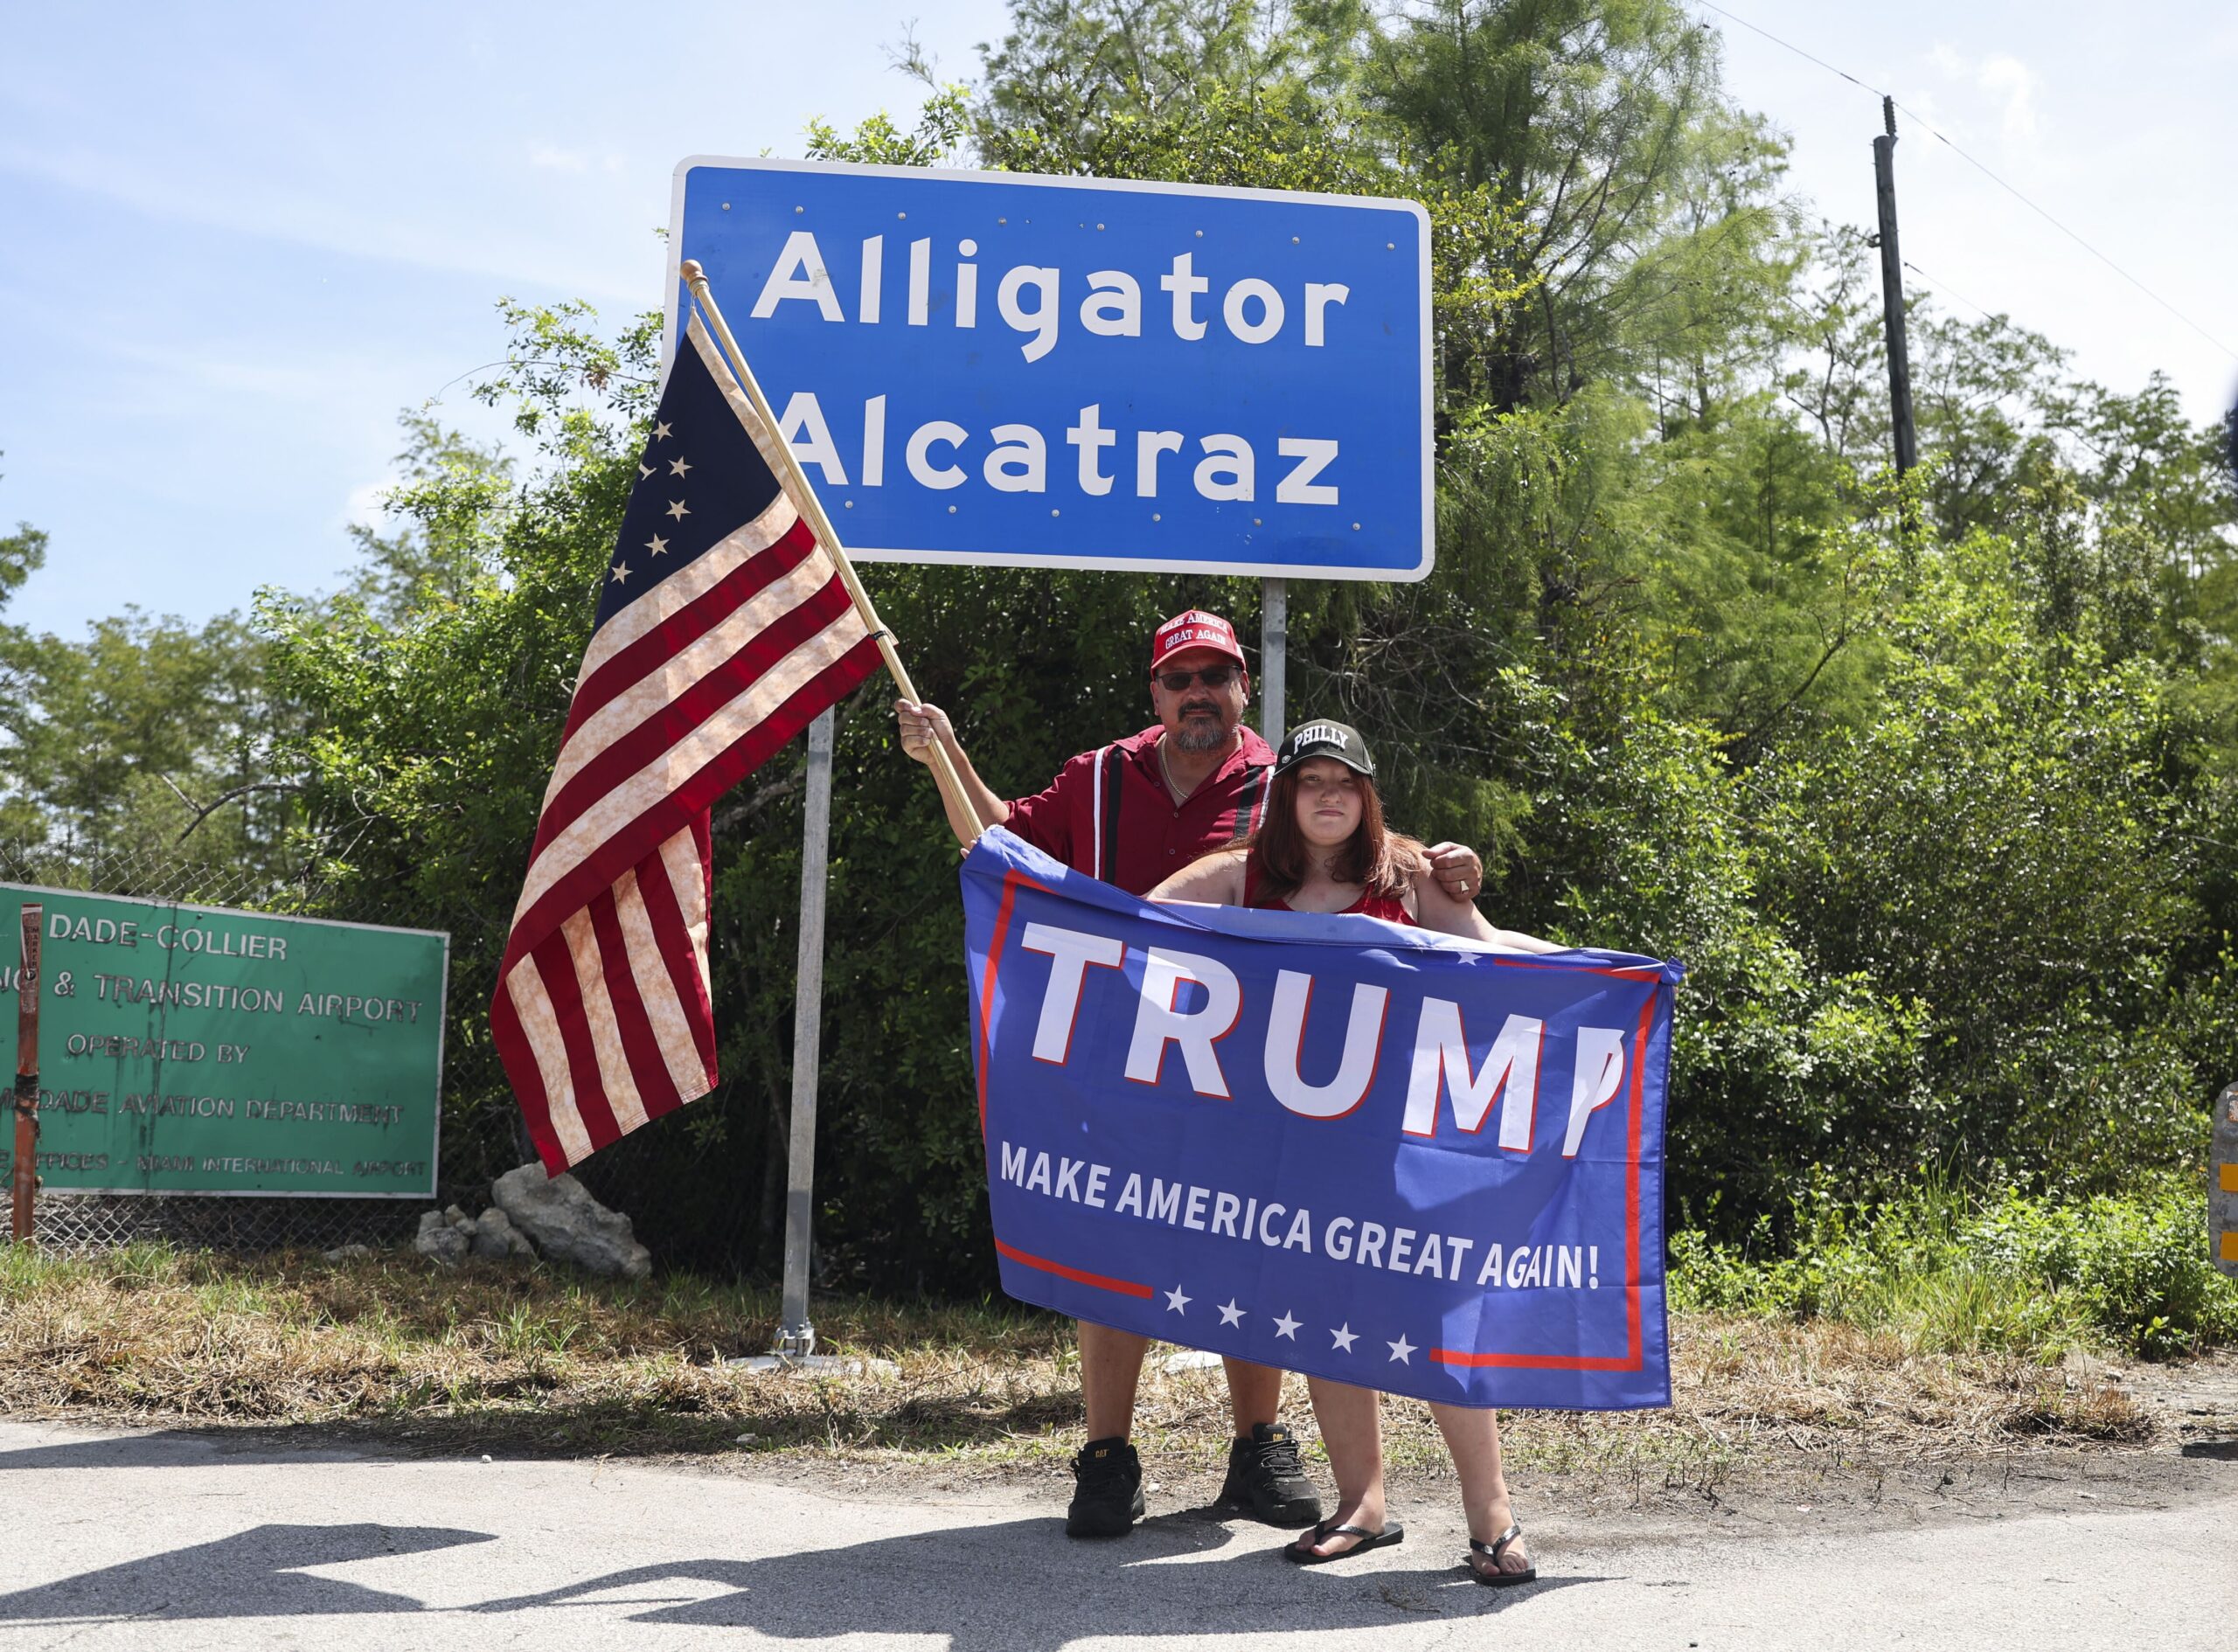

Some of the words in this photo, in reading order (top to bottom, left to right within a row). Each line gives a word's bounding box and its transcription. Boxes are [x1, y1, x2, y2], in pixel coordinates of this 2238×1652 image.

[751, 232, 1349, 363] Alligator
[779, 392, 1339, 505] Alcatraz
[1165, 629, 1193, 650] GREAT
[1294, 725, 1349, 755] PHILLY
[49, 913, 288, 961] DADE-COLLIER
[54, 971, 75, 996] &
[94, 974, 283, 1014] TRANSITION
[297, 993, 422, 1024] AIRPORT
[67, 1034, 206, 1063] OPERATED
[218, 1044, 251, 1065] BY
[1021, 920, 1626, 1159] TRUMP
[119, 1093, 234, 1119] AVIATION
[246, 1099, 405, 1124] DEPARTMENT
[35, 1151, 109, 1172] FFICES
[202, 1157, 344, 1176] INTERNATIONAL
[352, 1161, 427, 1178] AIRPORT
[1001, 1141, 1111, 1208] MAKE
[1115, 1173, 1312, 1253] AMERICA
[1324, 1217, 1474, 1281] GREAT
[1477, 1243, 1599, 1290] AGAIN!
